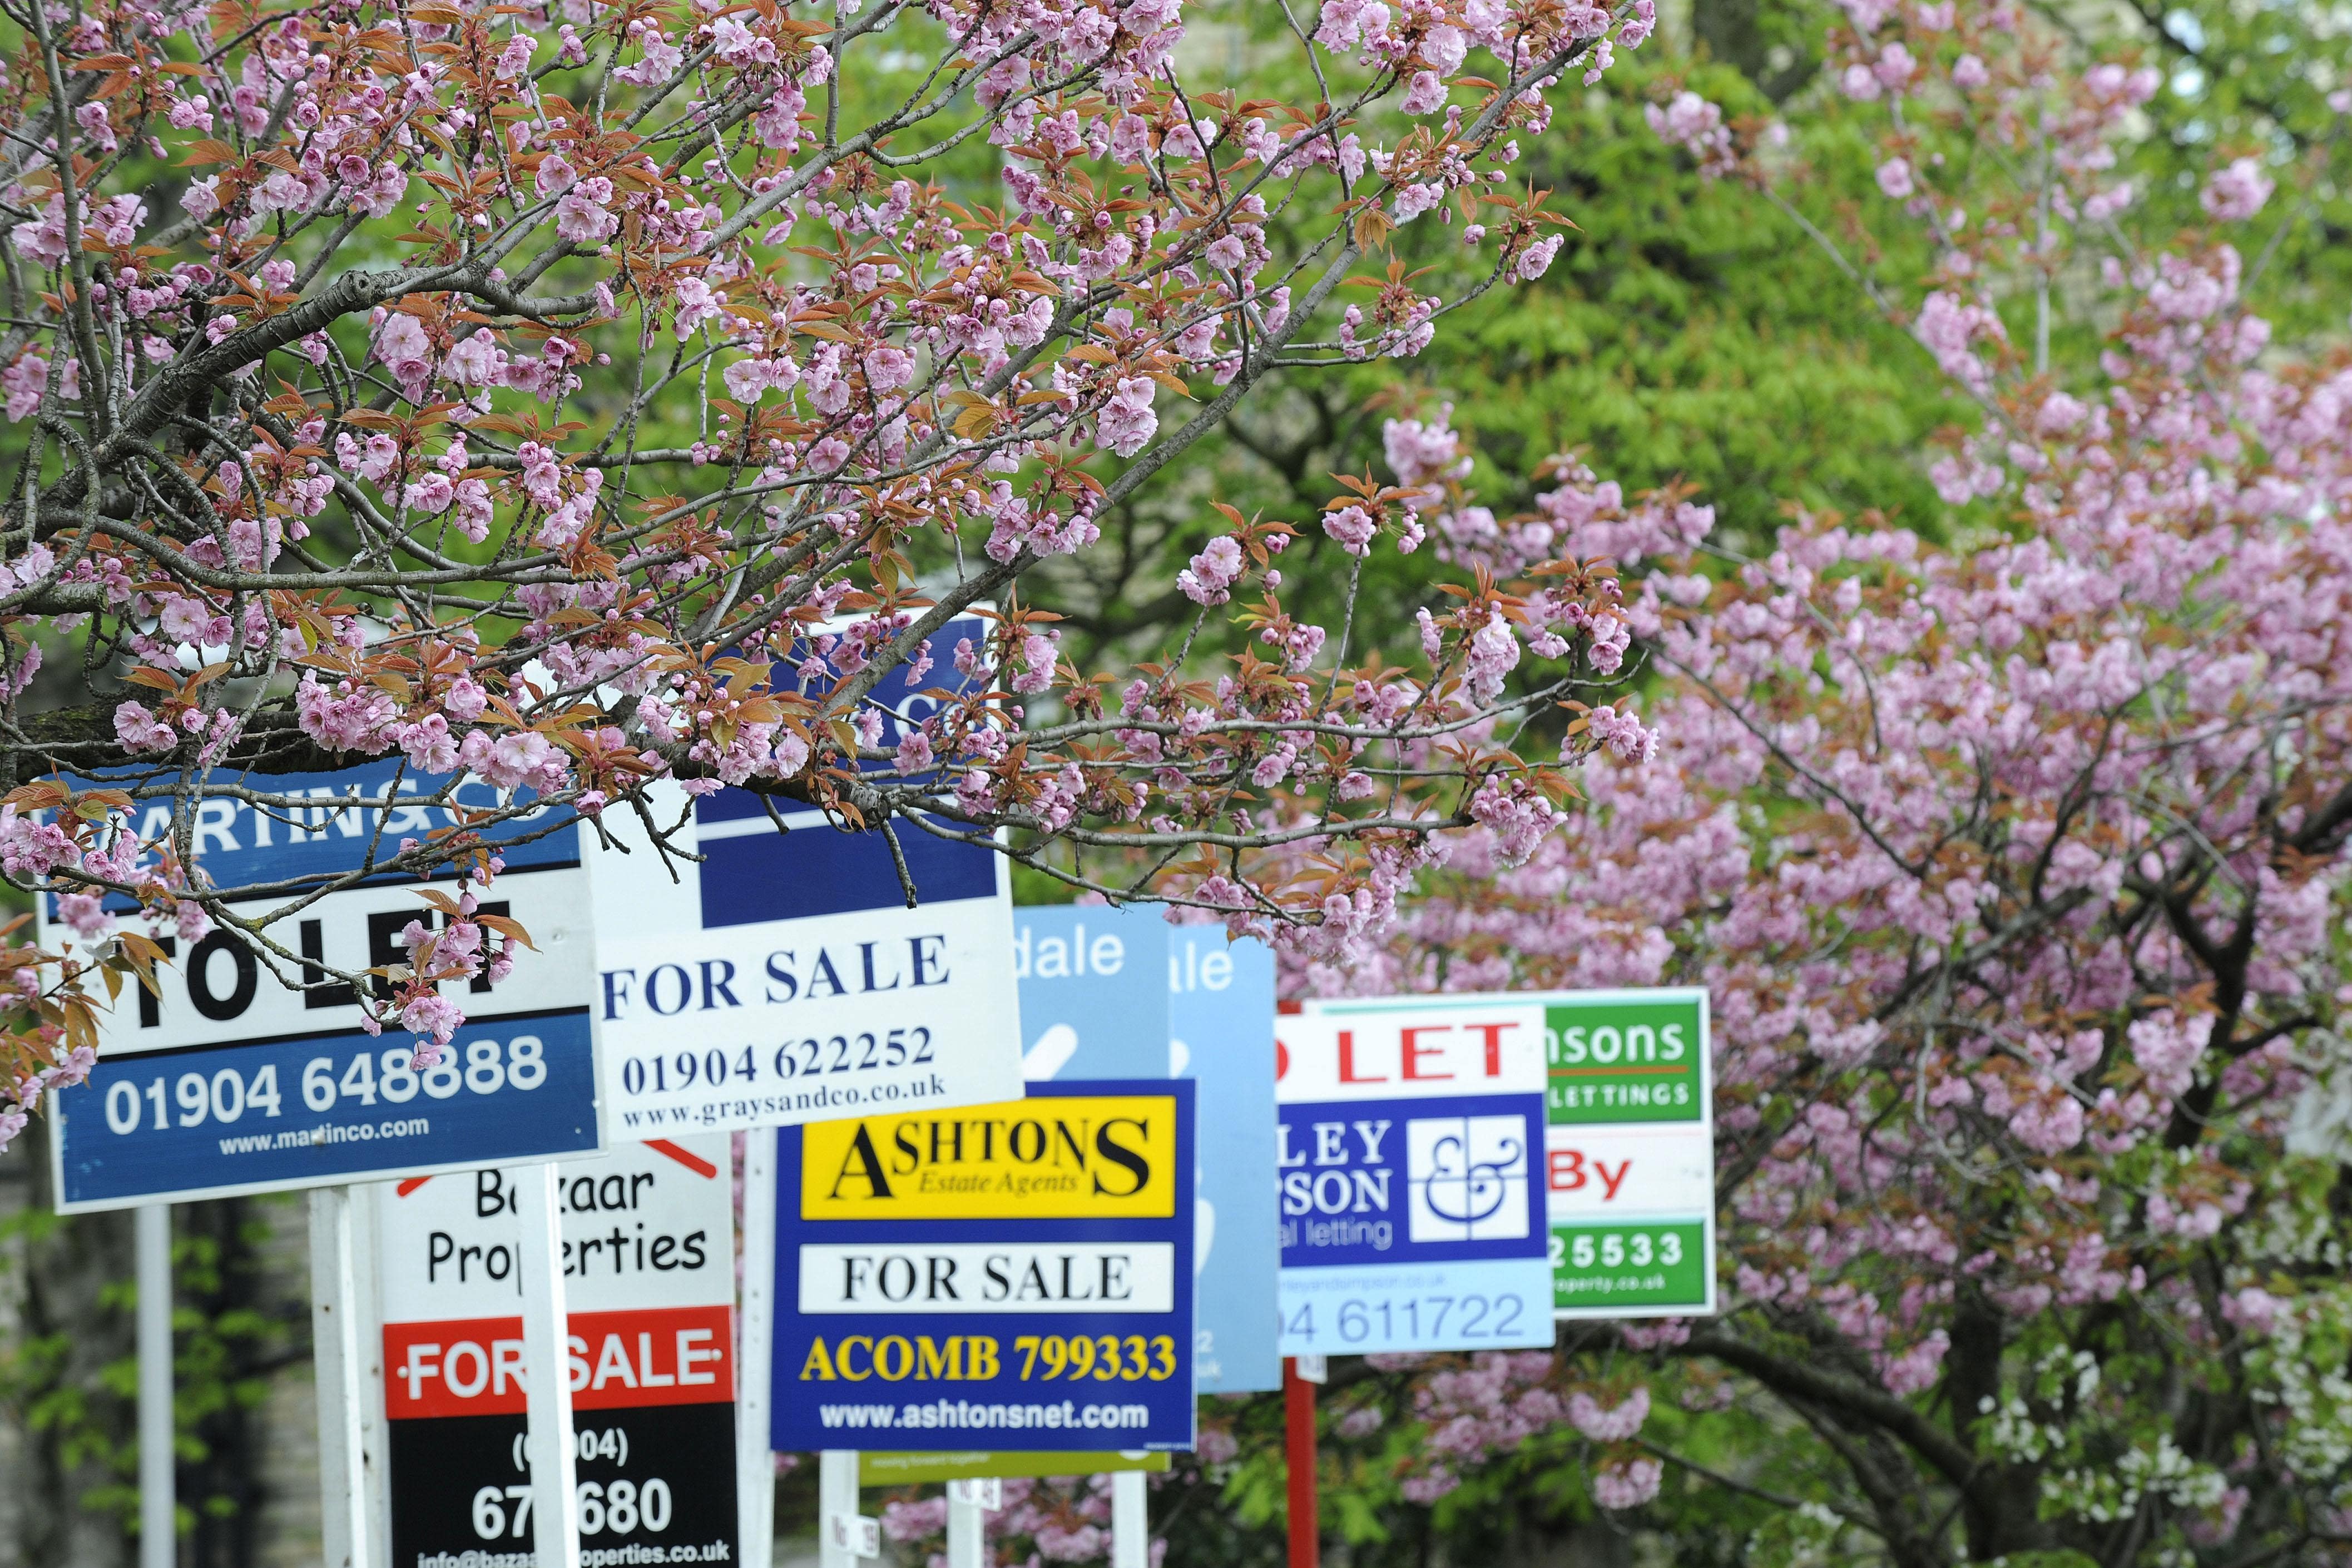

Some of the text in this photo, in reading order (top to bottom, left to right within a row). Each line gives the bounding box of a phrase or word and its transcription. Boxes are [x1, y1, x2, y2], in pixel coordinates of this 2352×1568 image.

[115, 900, 511, 1028] TO LET
[599, 934, 950, 1021] FOR SALE
[622, 1025, 935, 1096] 01904 622252
[1338, 1022, 1521, 1084] LET
[105, 1034, 548, 1135] 01904 648888
[623, 1073, 947, 1128] www.graysandco.co.uk
[1549, 1082, 1690, 1109] LETTINGS
[826, 1117, 1150, 1200] ASHTONS
[918, 1171, 1079, 1197] Estate Agents
[1548, 1149, 1633, 1203] By
[477, 1168, 654, 1218] Baar
[1277, 1169, 1394, 1216] SON
[429, 1222, 706, 1297] Prorties
[1305, 1215, 1393, 1252] letting
[1549, 1230, 1684, 1269] 25533
[840, 1254, 1132, 1302] FOR SALE
[1337, 1293, 1524, 1343] 611722
[407, 1328, 716, 1401] FOR SALE
[799, 1334, 1001, 1382] ACOMB
[1013, 1334, 1177, 1382] 799333
[819, 1398, 1149, 1429] www.ashtonsnet.com
[512, 1427, 628, 1472] (04)
[472, 1477, 672, 1541] 67680
